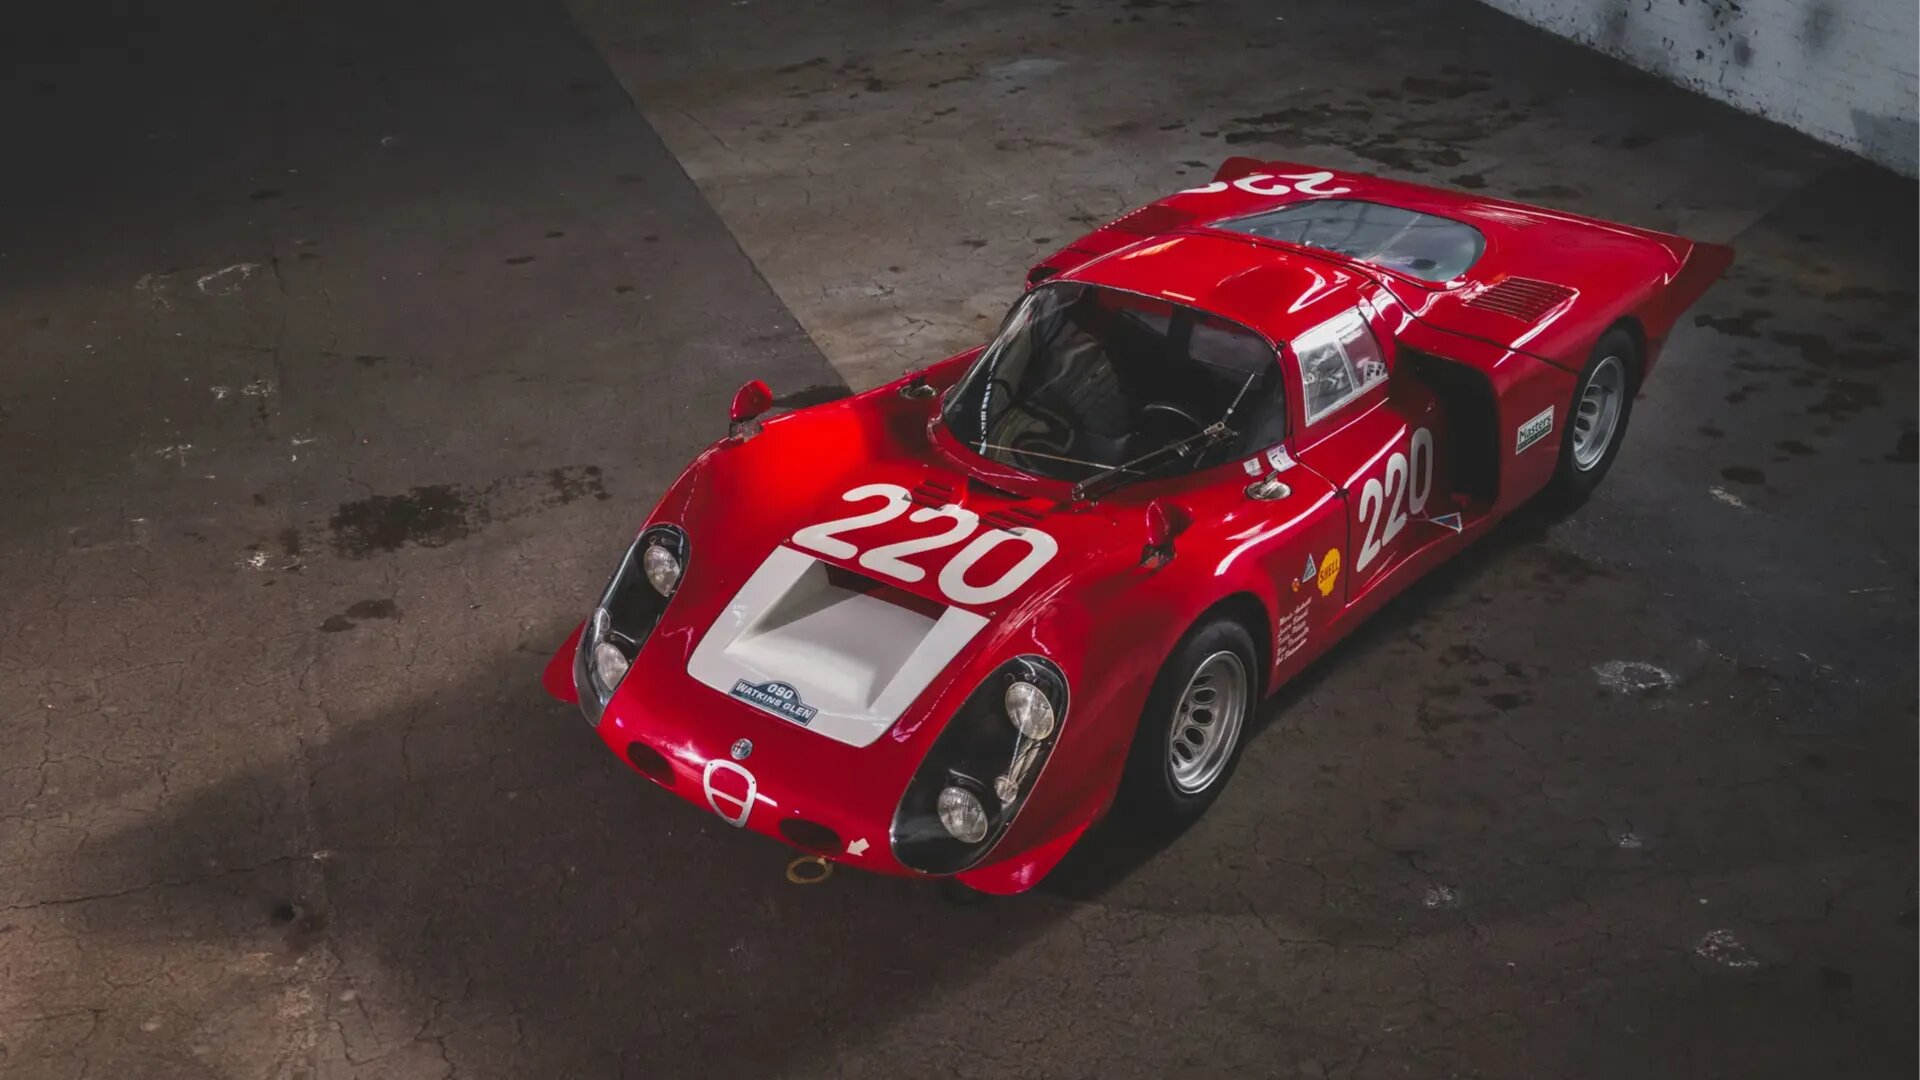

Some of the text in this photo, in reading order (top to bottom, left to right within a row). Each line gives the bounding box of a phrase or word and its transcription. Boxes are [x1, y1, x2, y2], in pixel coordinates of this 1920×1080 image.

[1519, 414, 1551, 442] Masters
[1356, 427, 1433, 572] 220
[792, 484, 1058, 604] 220
[1319, 558, 1339, 583] SHELL
[736, 682, 813, 719] WATKINS GLEN
[767, 684, 794, 699] 090
